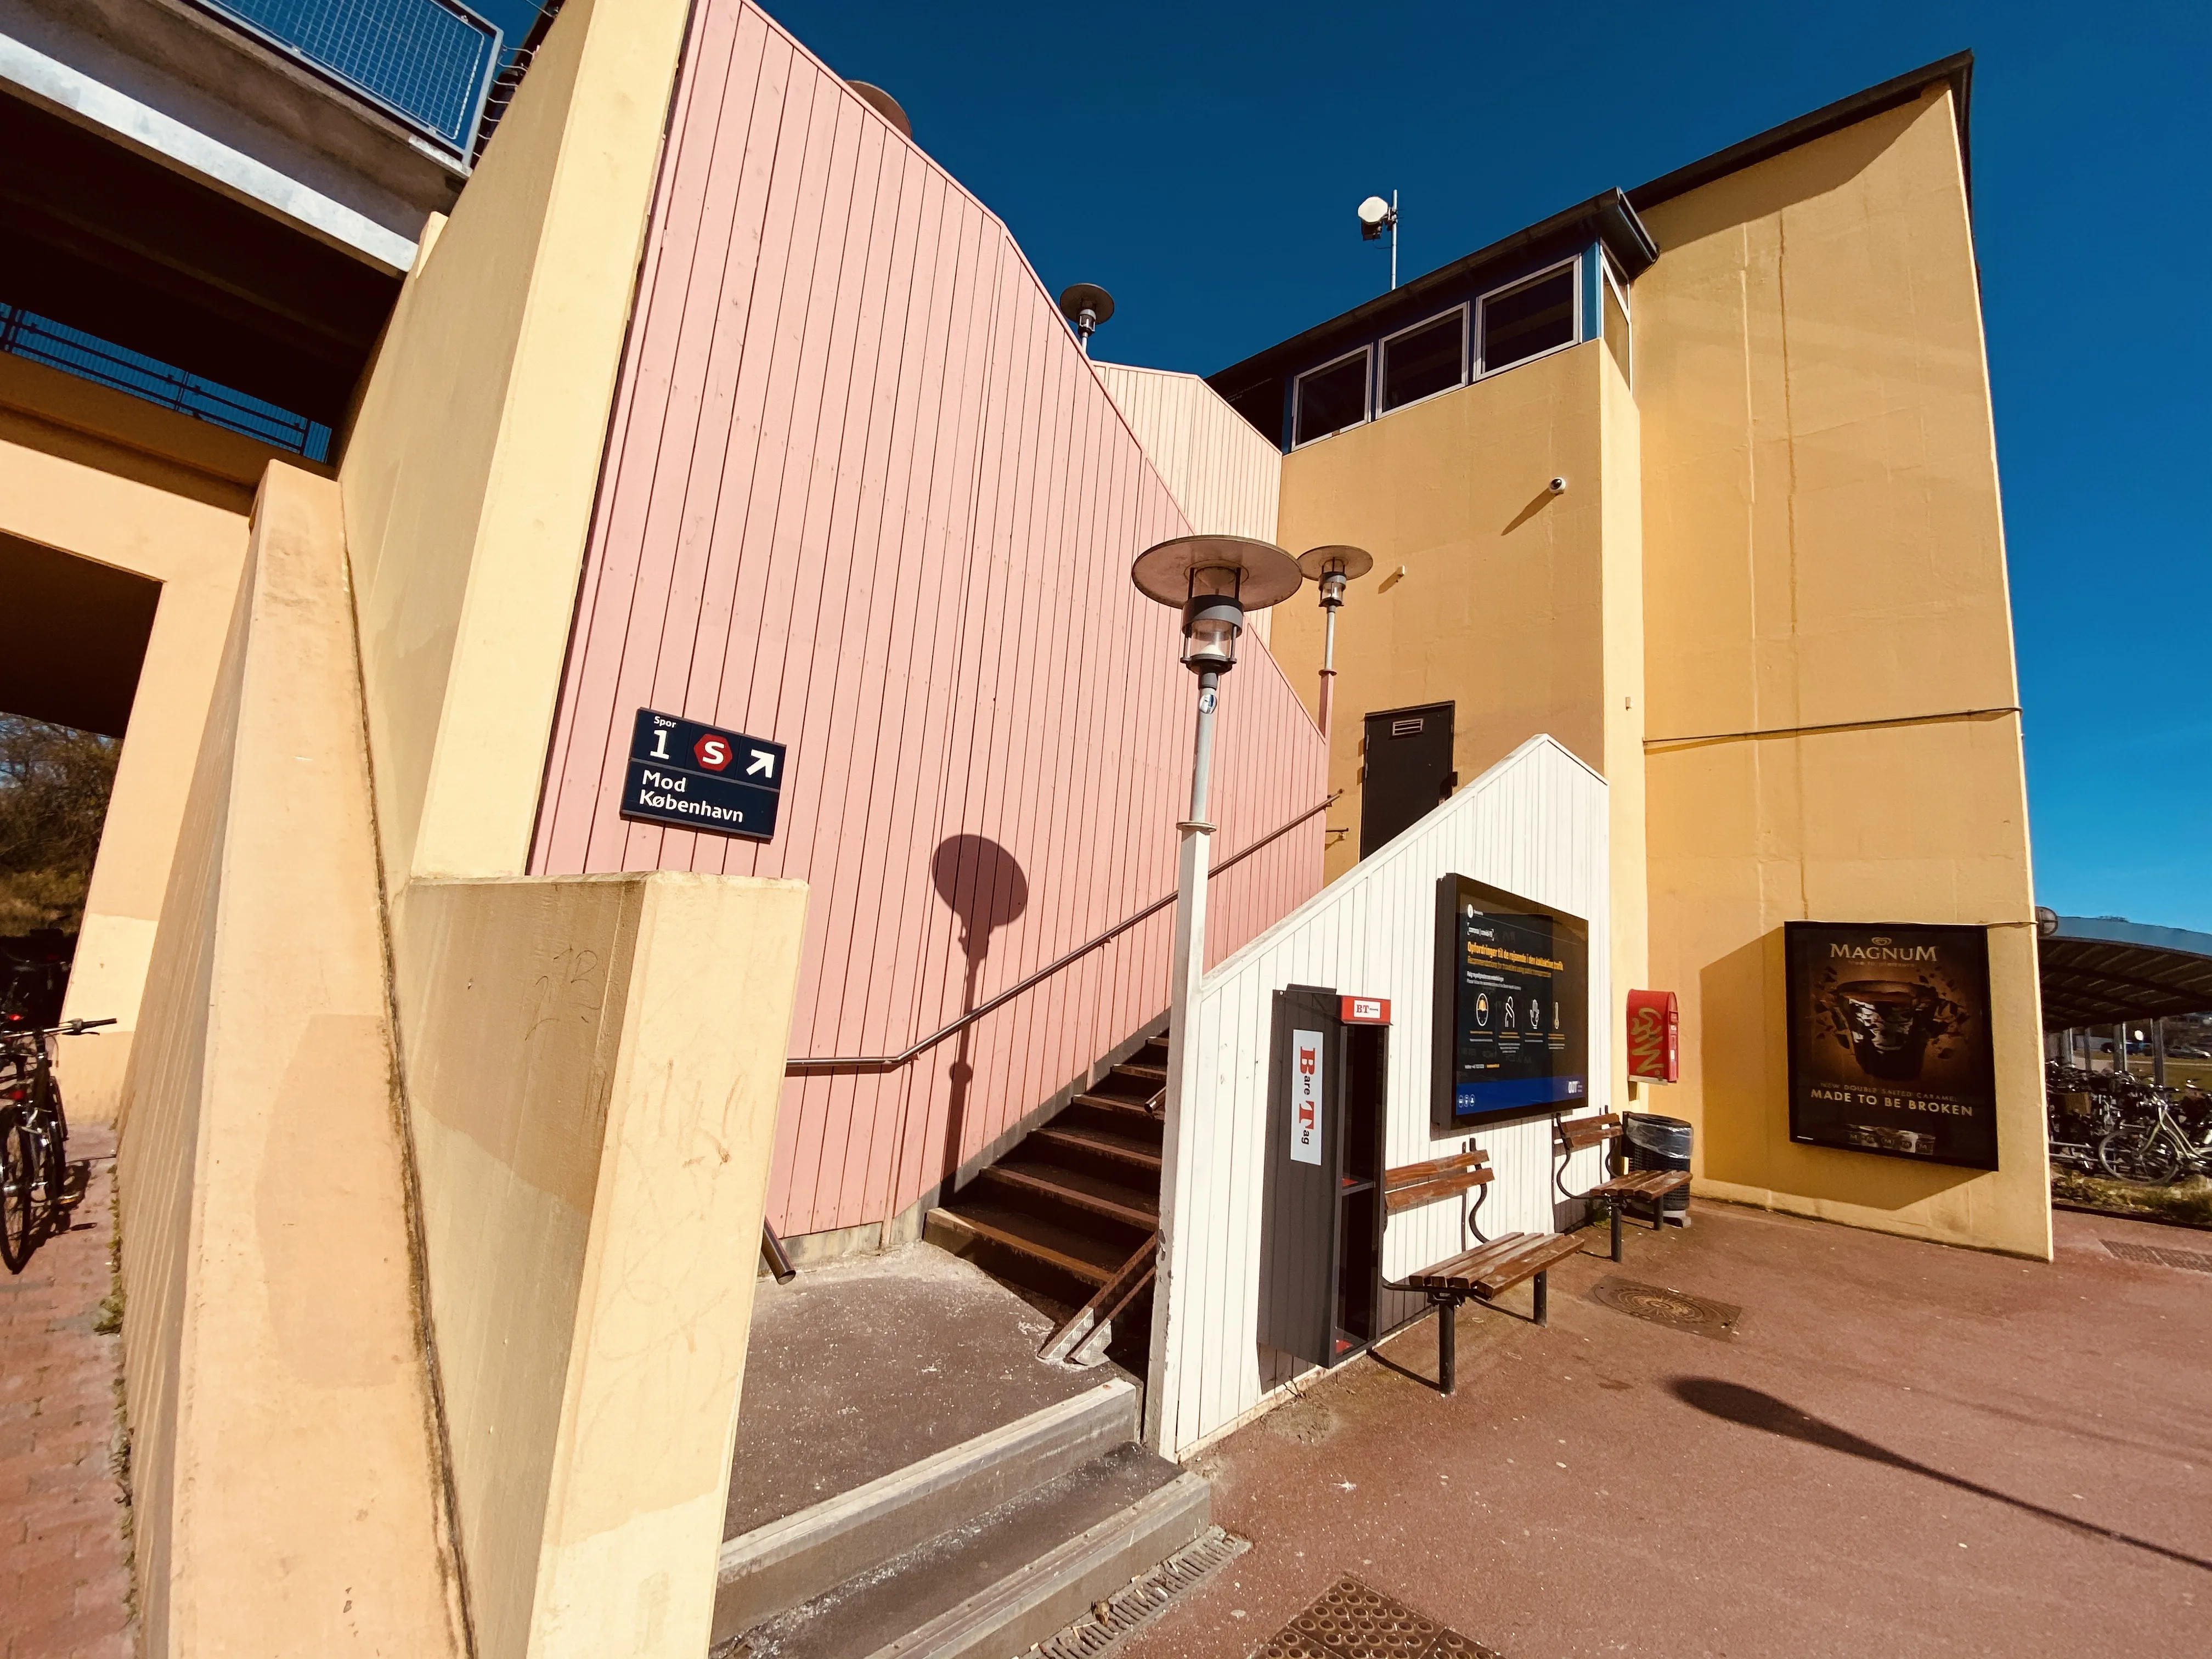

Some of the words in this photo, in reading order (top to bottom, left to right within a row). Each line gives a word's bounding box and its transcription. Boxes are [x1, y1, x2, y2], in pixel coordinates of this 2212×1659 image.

[653, 716, 676, 729] Spor
[650, 730, 670, 759] 1
[702, 741, 725, 765] S
[642, 769, 687, 793] Mod
[639, 789, 744, 823] København
[1829, 943, 1938, 962] MAGNUM
[1300, 1046, 1316, 1095] Bare
[1844, 1084, 1877, 1093] DOUBLE
[1811, 1088, 1852, 1103] MADE
[1857, 1094, 1877, 1105] TO
[1884, 1097, 1901, 1108] BE
[1909, 1100, 1974, 1117] BROKEN
[1299, 1100, 1314, 1146] Tag
